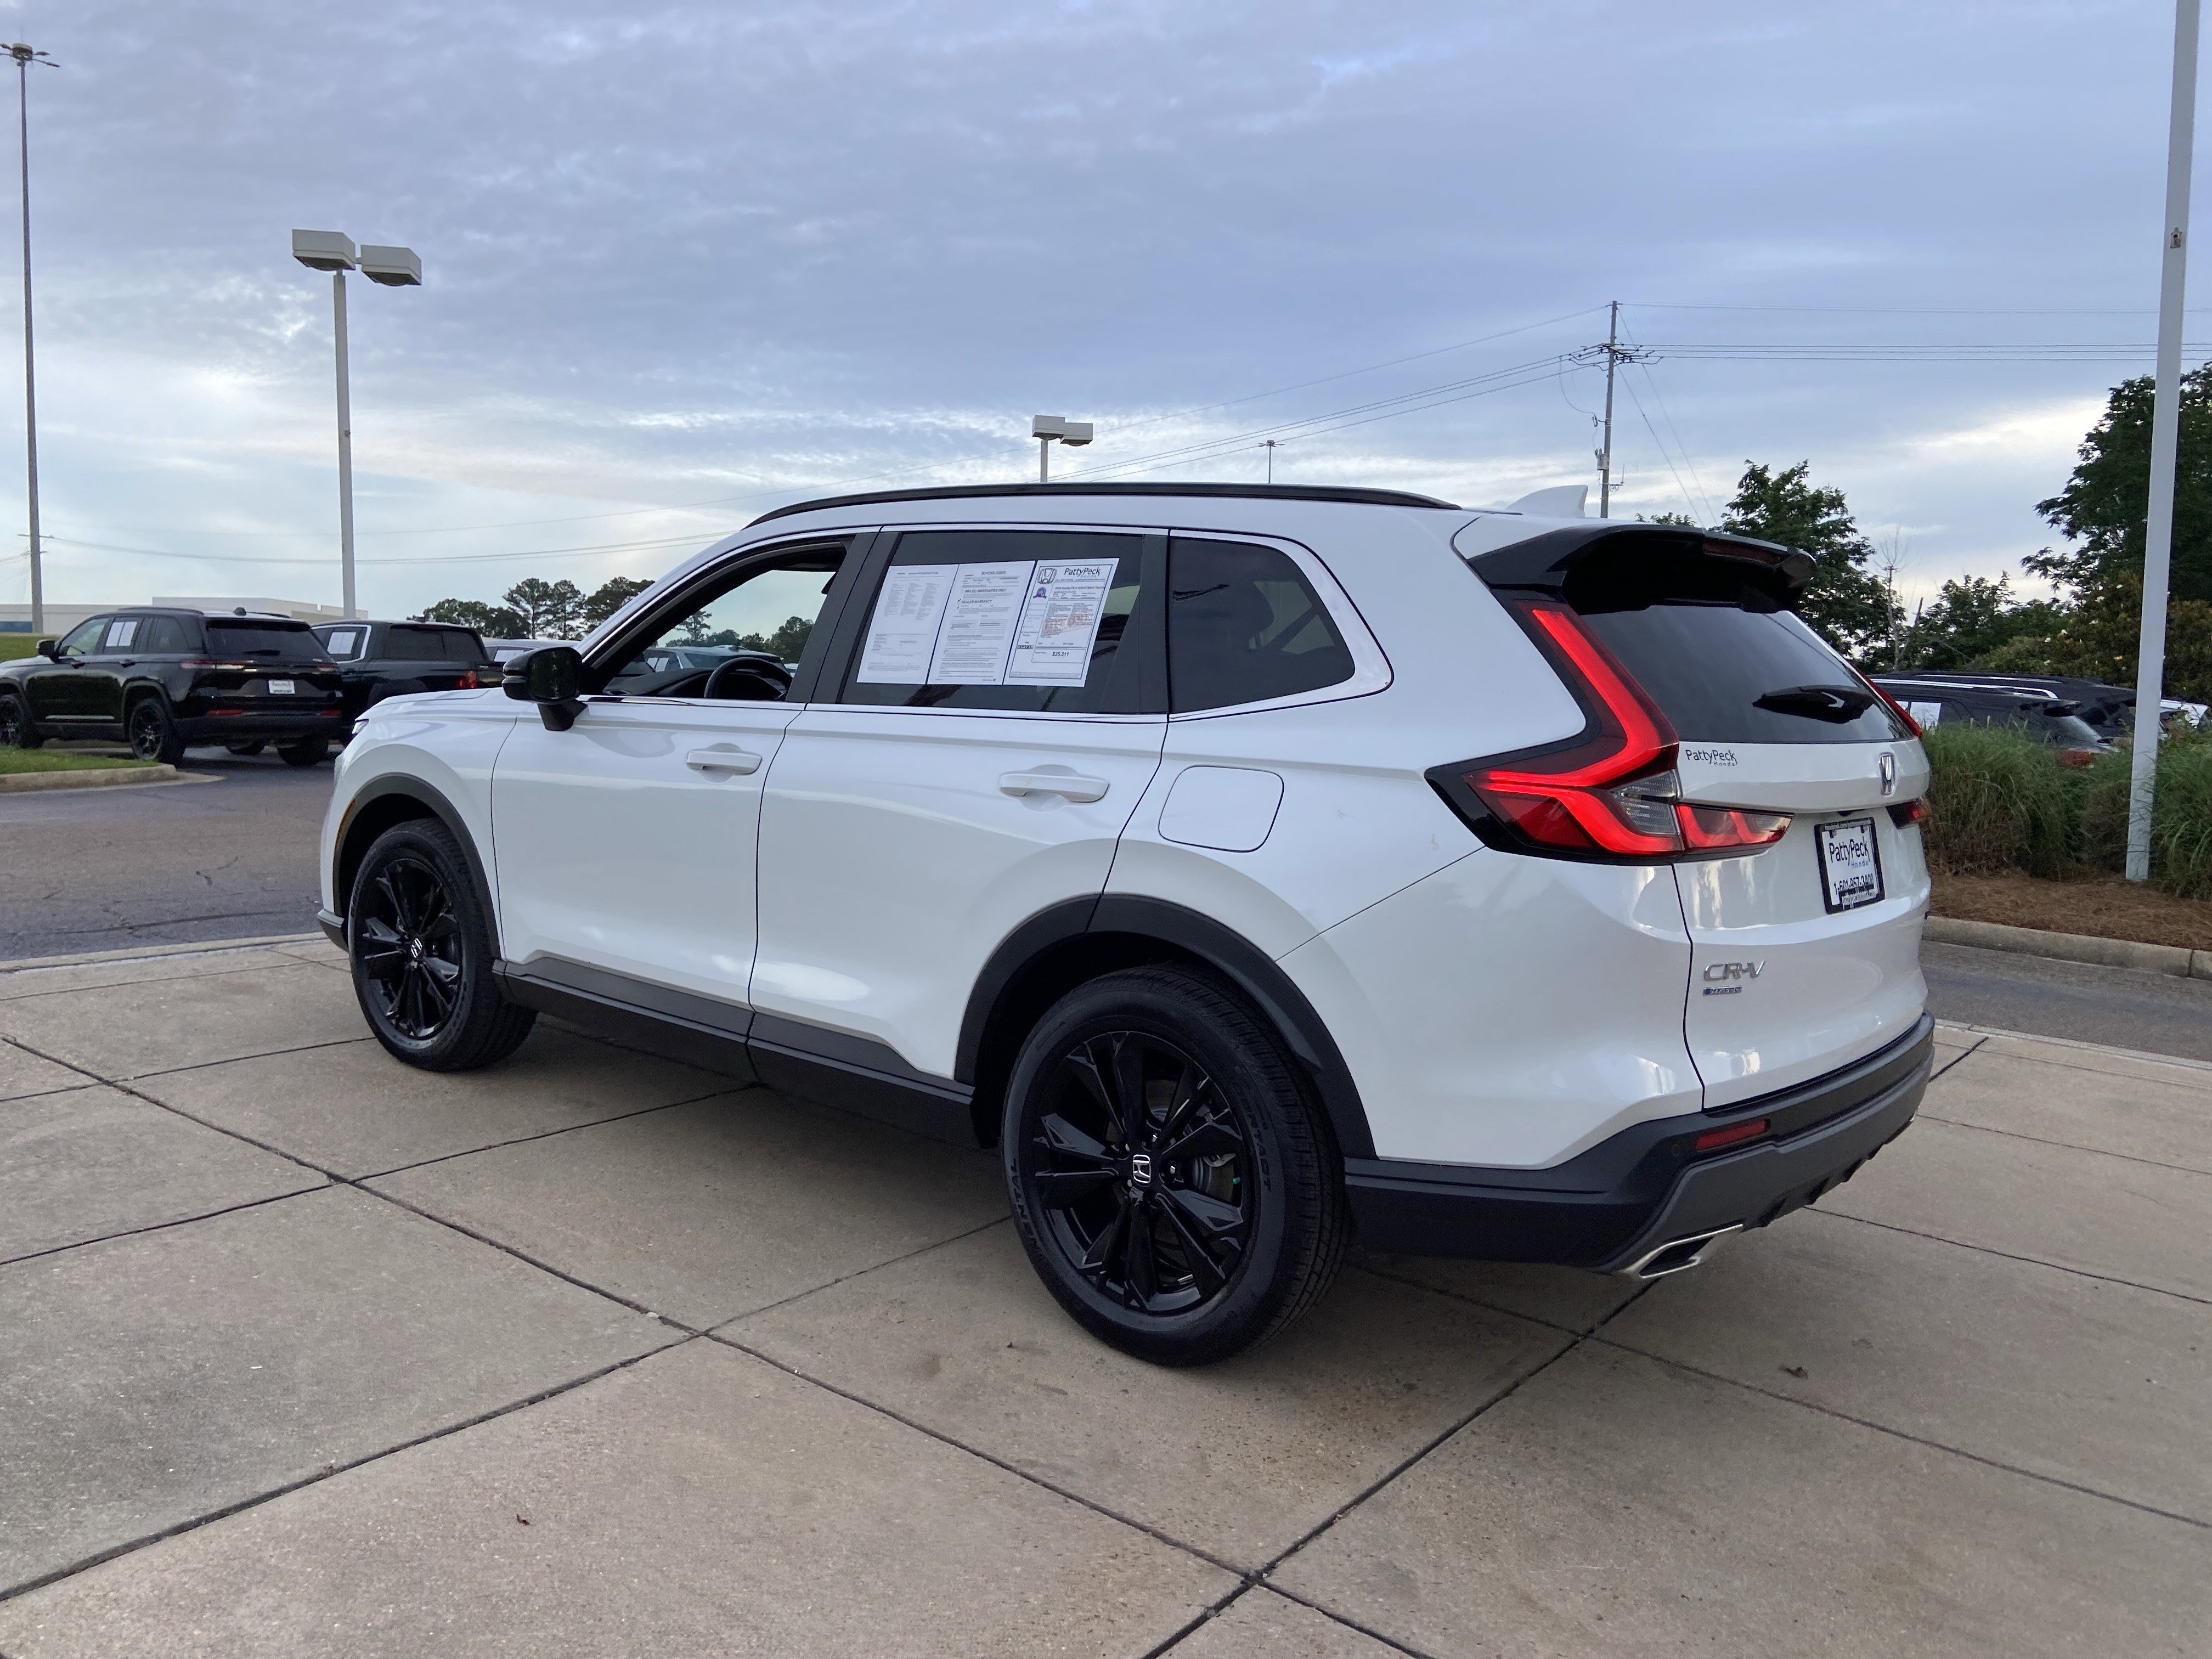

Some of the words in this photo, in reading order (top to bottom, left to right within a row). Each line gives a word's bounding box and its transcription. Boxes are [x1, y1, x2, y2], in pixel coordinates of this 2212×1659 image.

[1064, 567, 1101, 577] PattyPeck
[1685, 749, 1738, 765] PattyPeck
[1829, 836, 1870, 866] PattyPeck
[1703, 960, 1767, 981] CR-V
